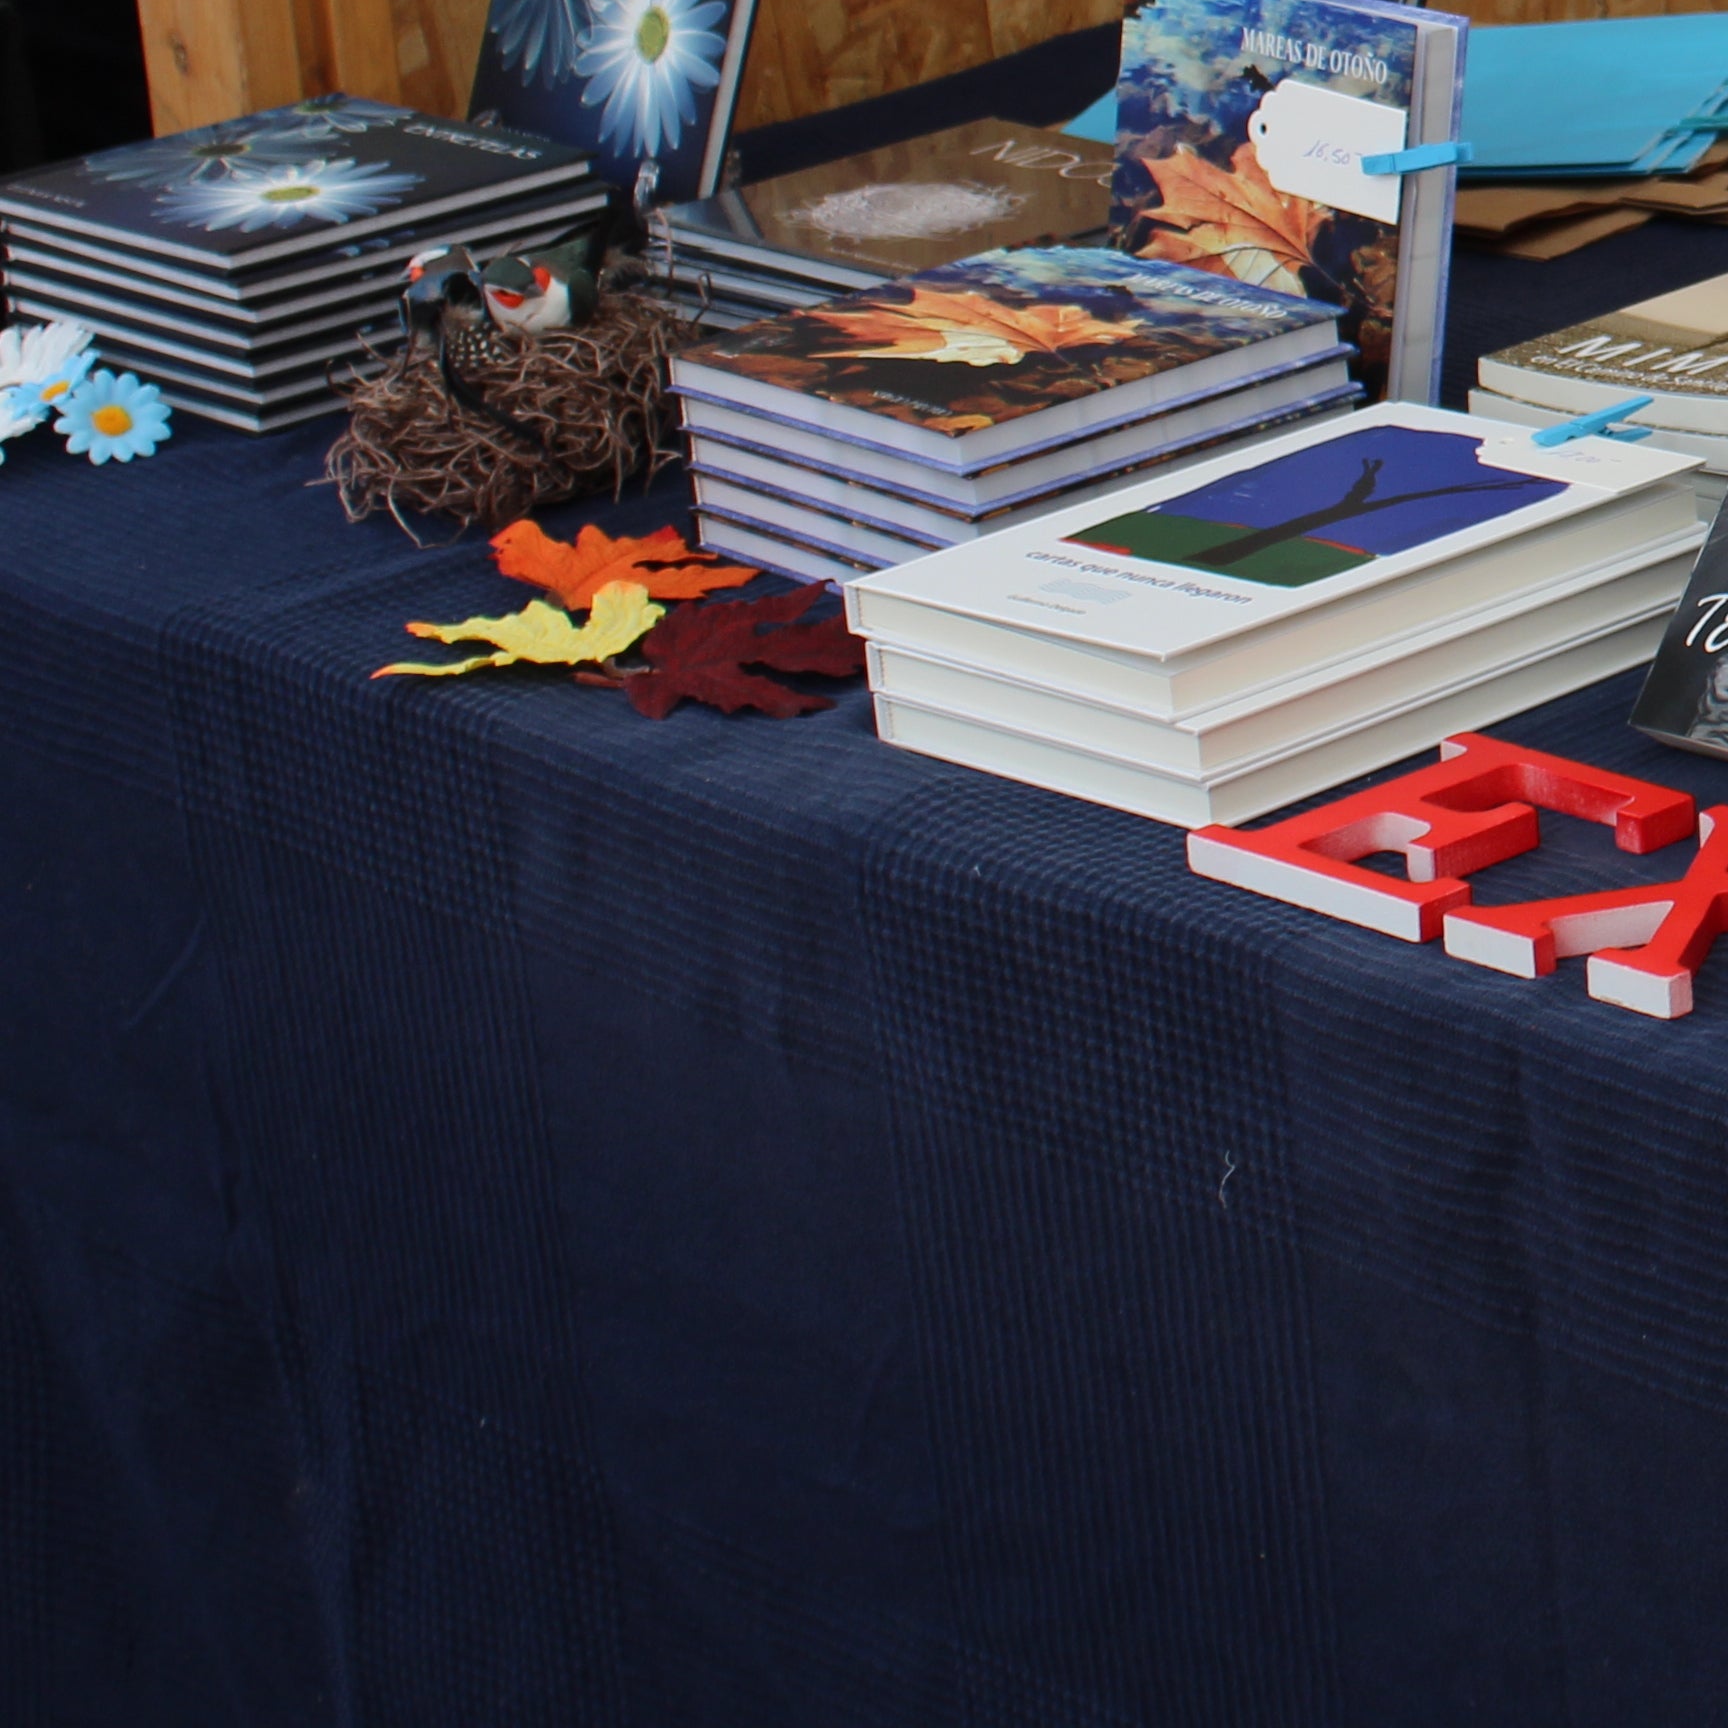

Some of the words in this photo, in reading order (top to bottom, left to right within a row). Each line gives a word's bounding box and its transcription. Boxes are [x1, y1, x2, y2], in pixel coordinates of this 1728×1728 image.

[1240, 26, 1303, 64] MAREAS
[1305, 41, 1328, 70] DE
[1329, 46, 1390, 86] OTOÑO
[968, 138, 1121, 189] NIDO
